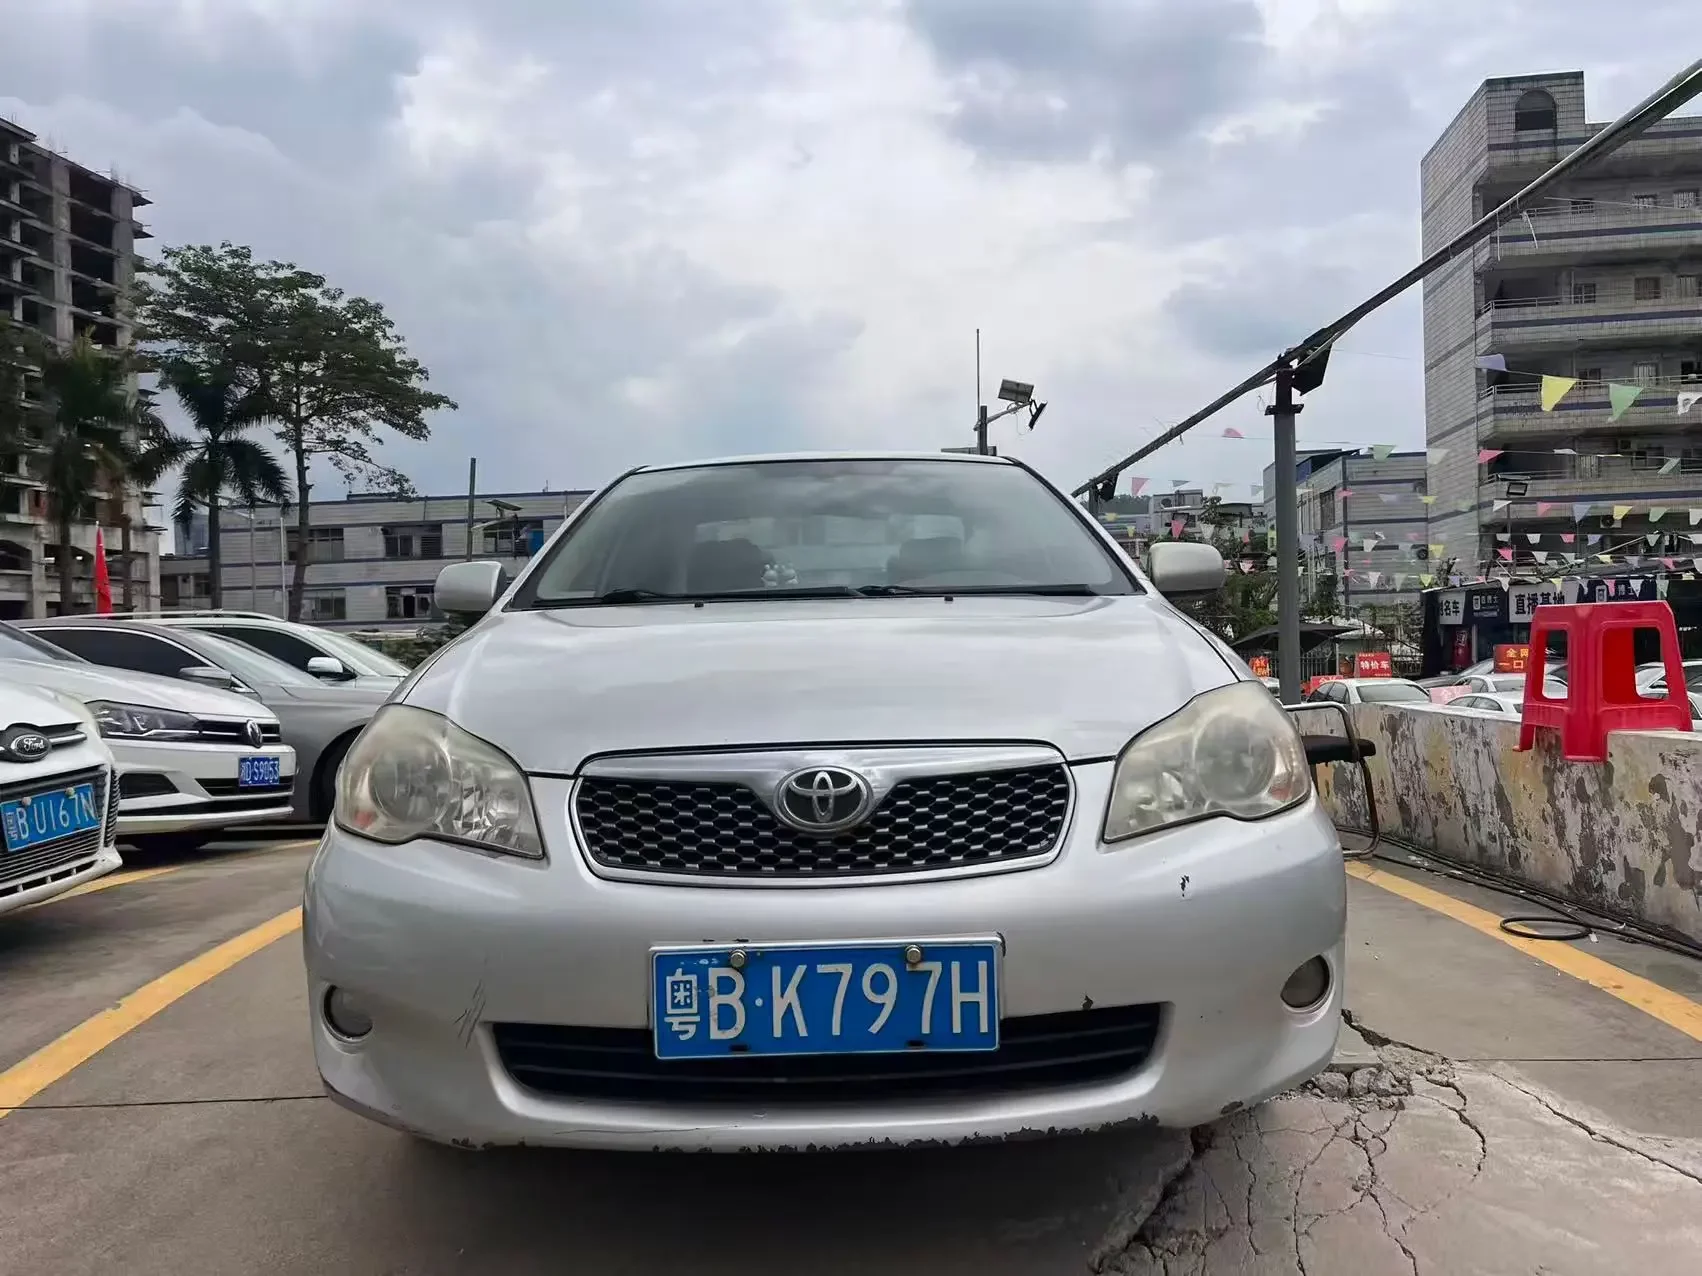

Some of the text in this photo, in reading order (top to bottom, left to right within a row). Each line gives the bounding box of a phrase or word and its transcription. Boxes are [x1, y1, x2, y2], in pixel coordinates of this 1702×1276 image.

[1360, 660, 1390, 670] 特价车
[24, 738, 45, 752] Ford
[664, 961, 989, 1041] 粤B·K797H
